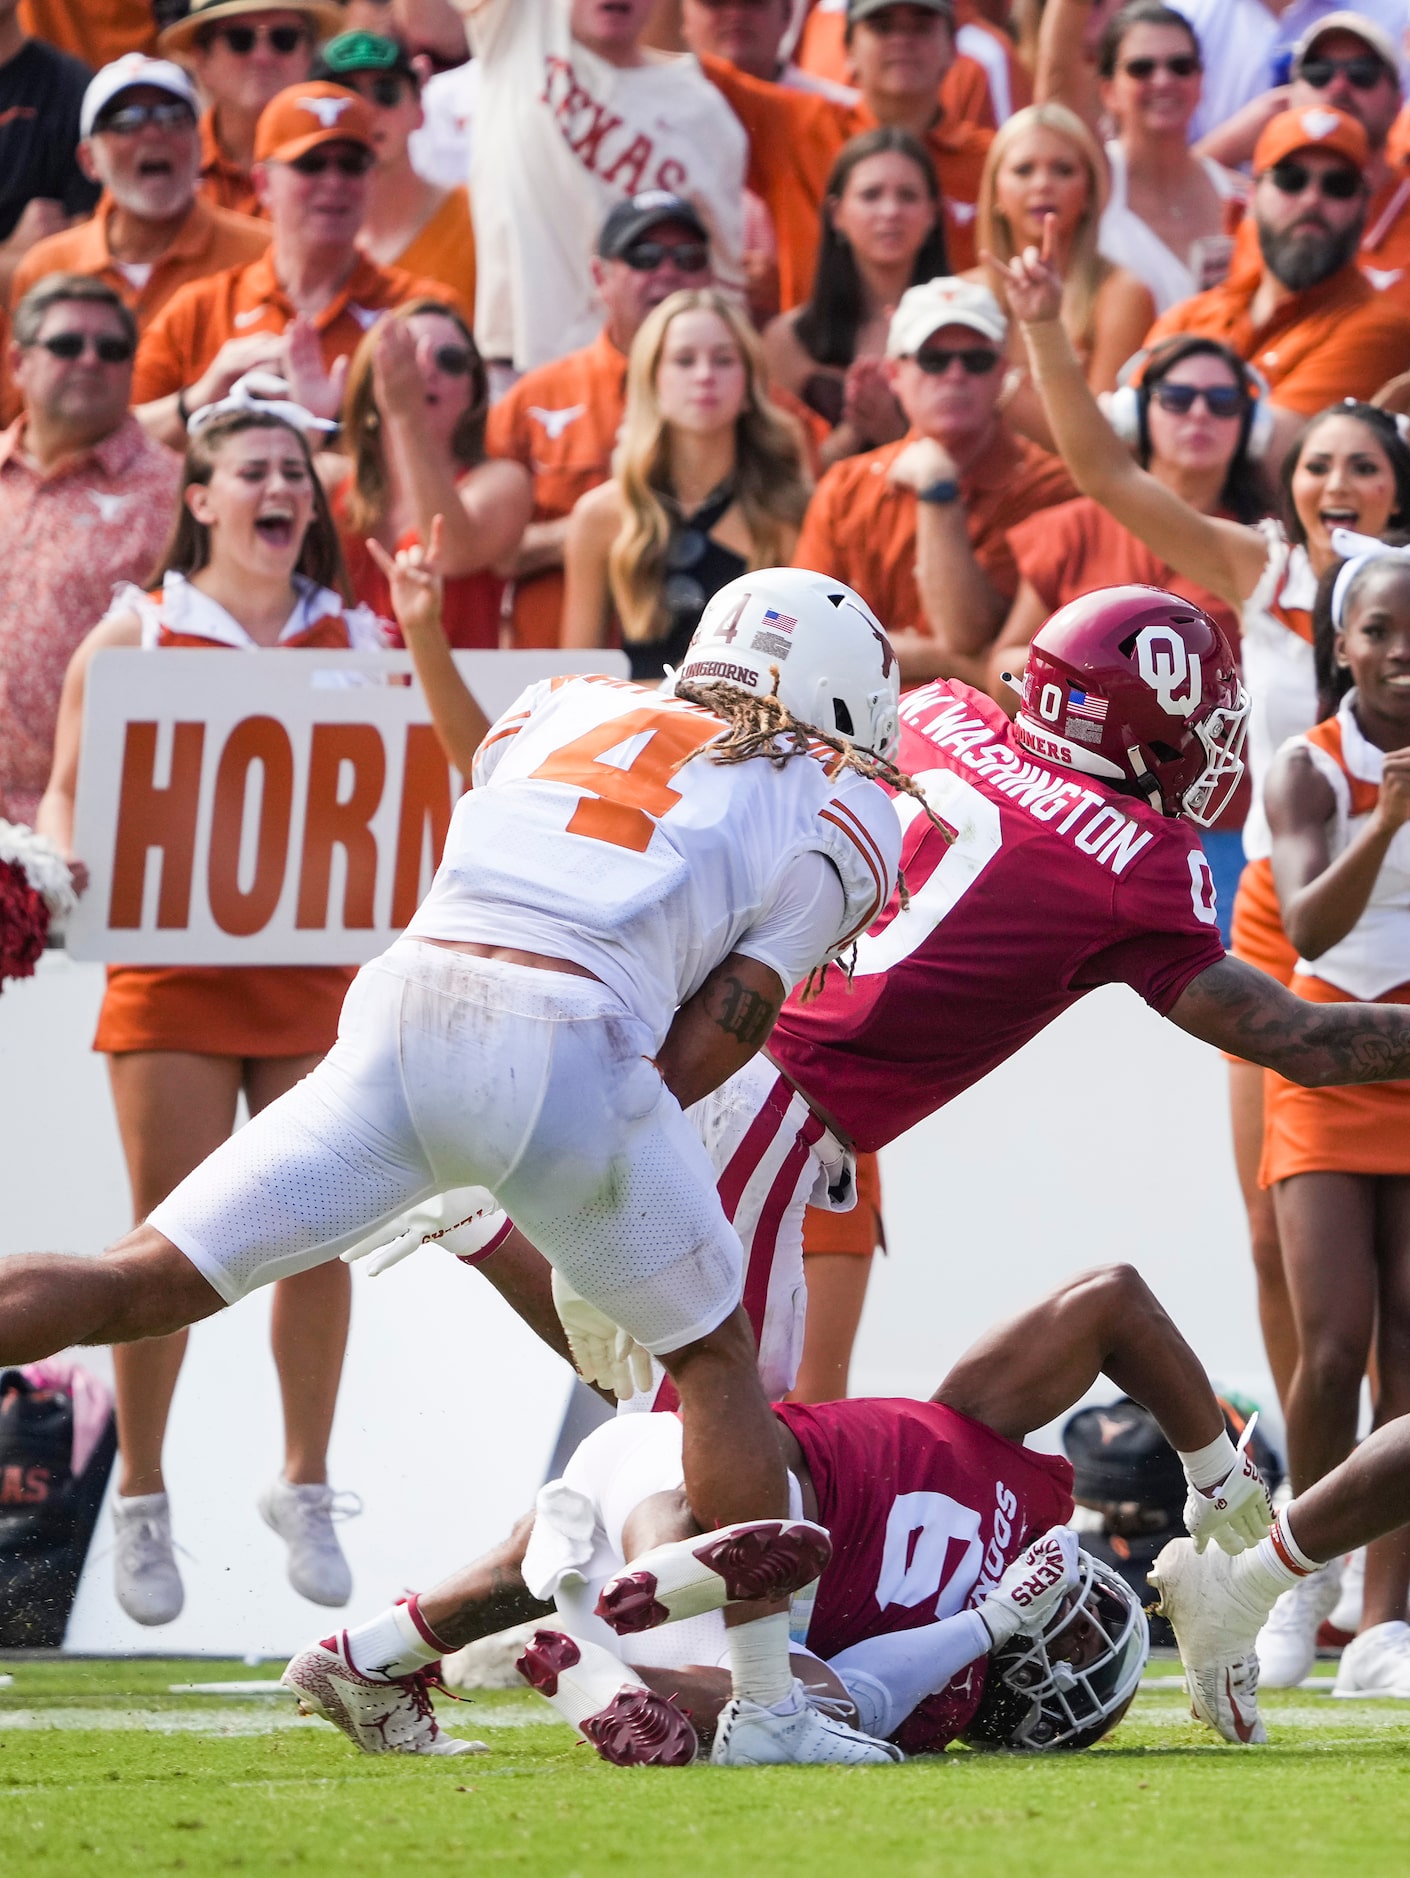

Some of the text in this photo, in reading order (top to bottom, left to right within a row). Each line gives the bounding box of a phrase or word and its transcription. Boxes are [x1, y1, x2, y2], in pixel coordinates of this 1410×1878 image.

[713, 592, 752, 644] 4
[679, 661, 759, 687] LONGHORNS
[1039, 683, 1062, 722] 0
[1014, 726, 1072, 764] ONERS
[528, 708, 732, 853] 4
[921, 701, 1154, 875] WASHINGTON
[1187, 849, 1217, 925] 0
[0, 1466, 49, 1504] AS
